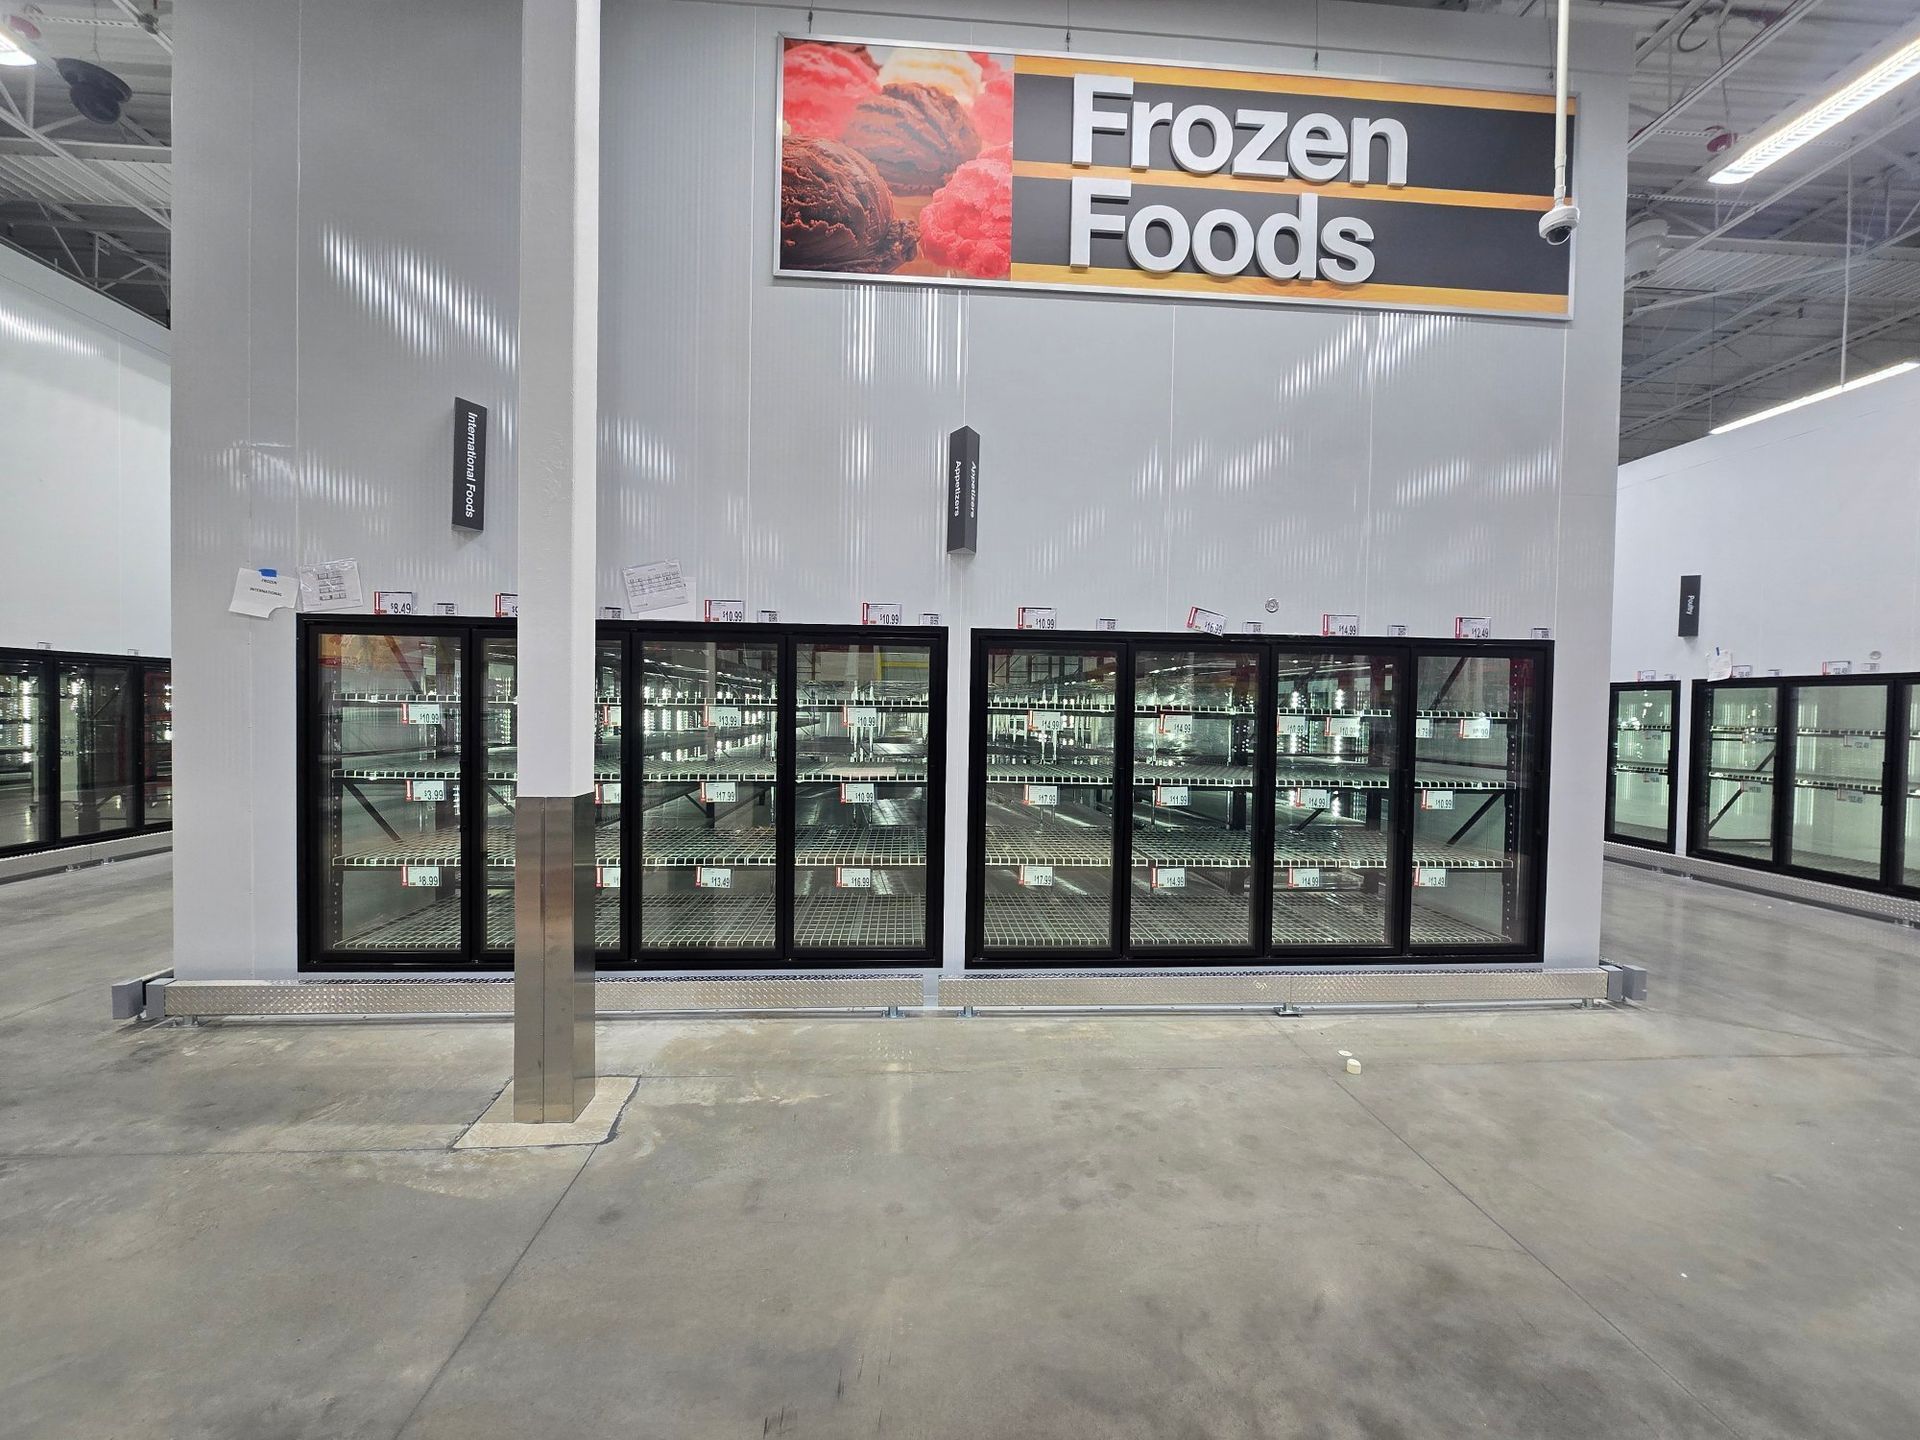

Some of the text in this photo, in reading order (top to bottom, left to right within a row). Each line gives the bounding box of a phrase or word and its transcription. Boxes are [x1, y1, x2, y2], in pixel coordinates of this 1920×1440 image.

[1072, 73, 1409, 188] Frozen
[1069, 176, 1376, 285] Foods
[465, 412, 478, 518] International Foods
[954, 460, 962, 517] Appetizers
[390, 603, 411, 614] $8.49
[722, 611, 743, 622] $10.99
[879, 614, 899, 625] $10.99
[1035, 618, 1055, 629] $10.99
[1204, 622, 1223, 635] $16.99
[1338, 625, 1357, 636] $14.99
[1471, 628, 1489, 639] $12.49
[420, 713, 439, 724] $10.99
[719, 715, 737, 726] $13.99
[1042, 720, 1059, 730] $14.99
[424, 790, 443, 801] $3.99
[716, 791, 735, 801] $17.99
[419, 876, 439, 886] $8.99
[852, 877, 870, 887] $16.99
